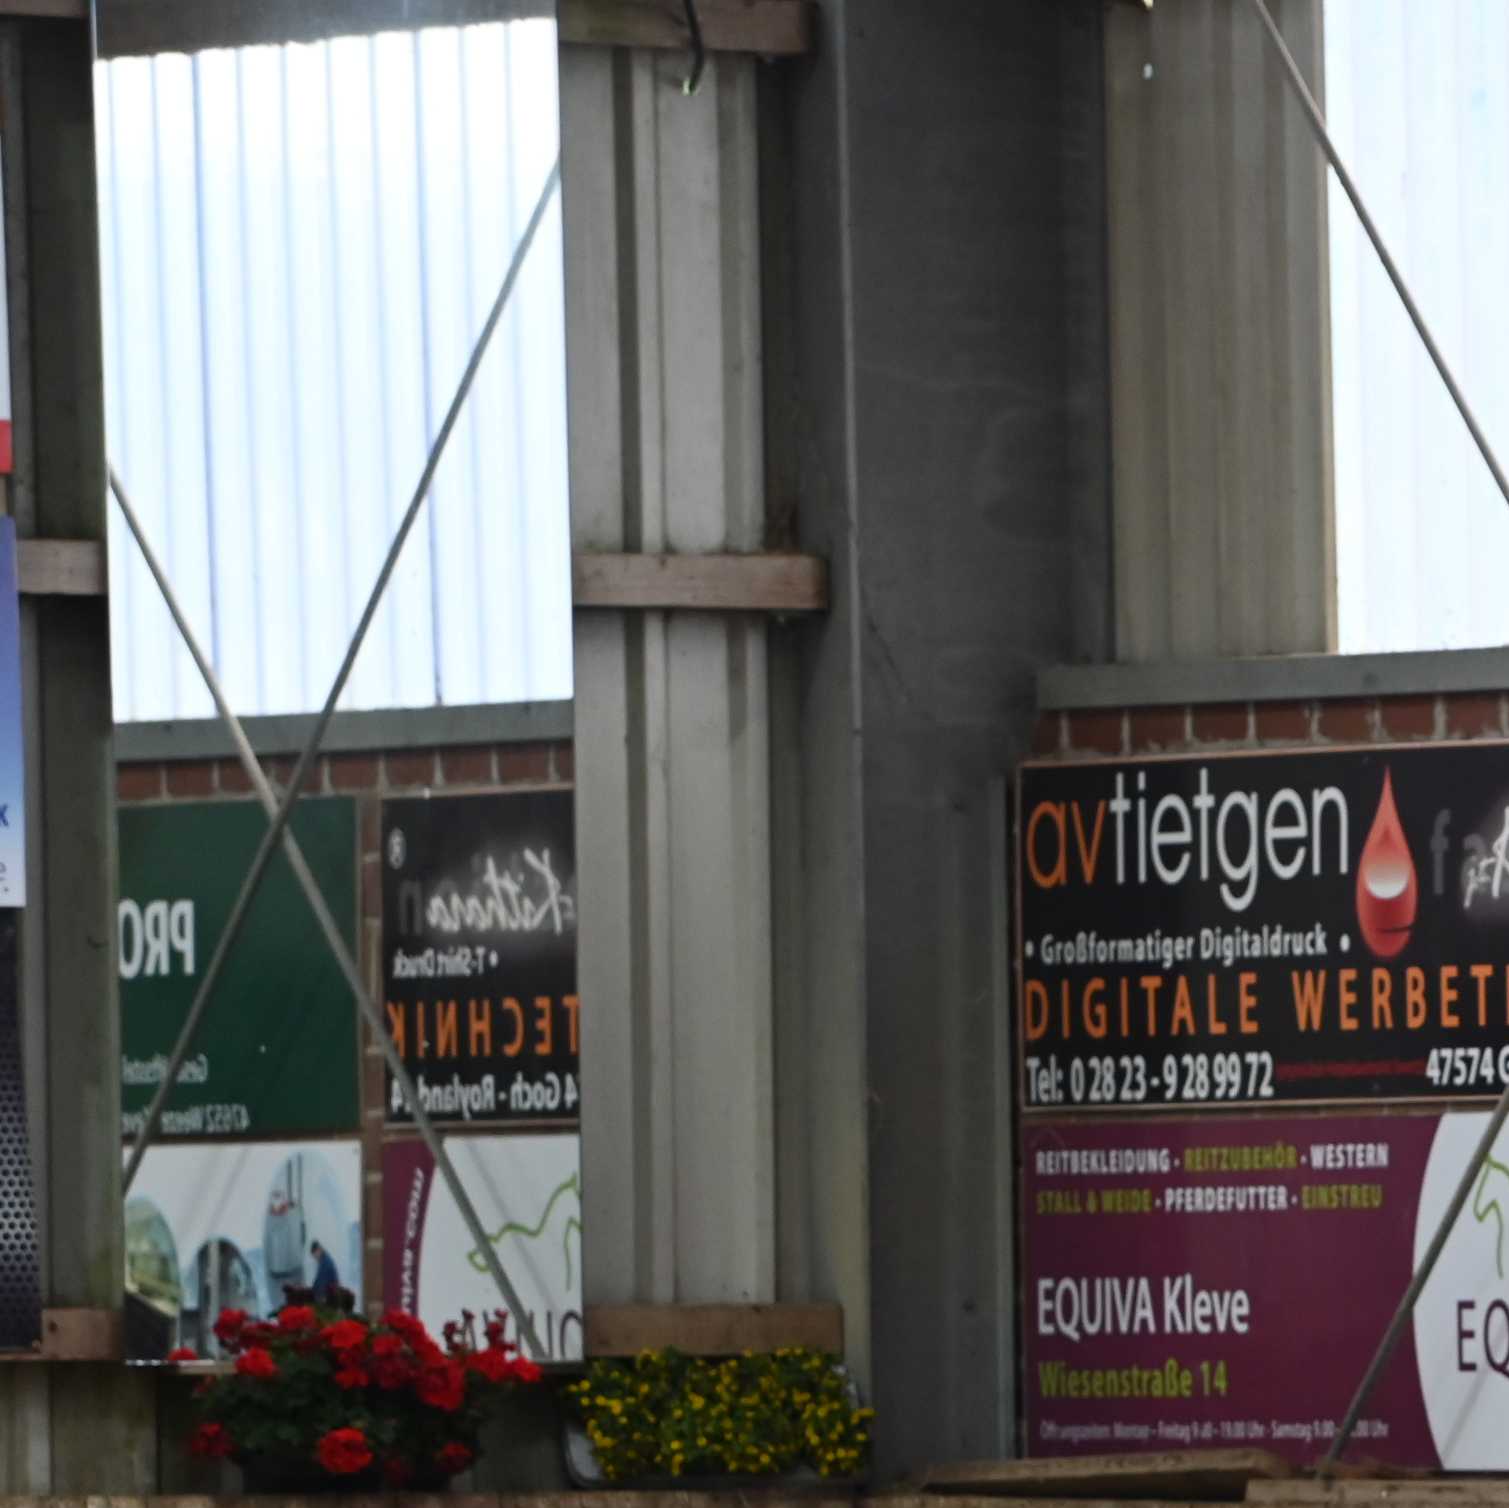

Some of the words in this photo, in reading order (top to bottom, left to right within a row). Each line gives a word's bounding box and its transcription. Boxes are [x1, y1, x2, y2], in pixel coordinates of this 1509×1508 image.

[1040, 930, 1194, 970] Großformatiger
[1200, 922, 1327, 967] Digitaldruck
[1025, 972, 1259, 1041] DIGITALE
[1026, 1054, 1064, 1103] Tel:
[1425, 1046, 1495, 1087] 47574
[1036, 1148, 1171, 1176] REITBEKLEIDUNG
[1183, 1140, 1298, 1173] REITZUBEHÖR
[1310, 1142, 1390, 1169] WESTERN
[1036, 1190, 1082, 1215] STALL
[1102, 1189, 1152, 1213] WEIDE
[1164, 1185, 1289, 1213] PFERDEFUTTER
[1302, 1183, 1383, 1210] EINSTREU
[1037, 1276, 1156, 1343] EQUIVA
[1163, 1272, 1250, 1334] Kleve
[1038, 1357, 1194, 1398] Wiesenstraße
[1200, 1359, 1228, 1396] 14
